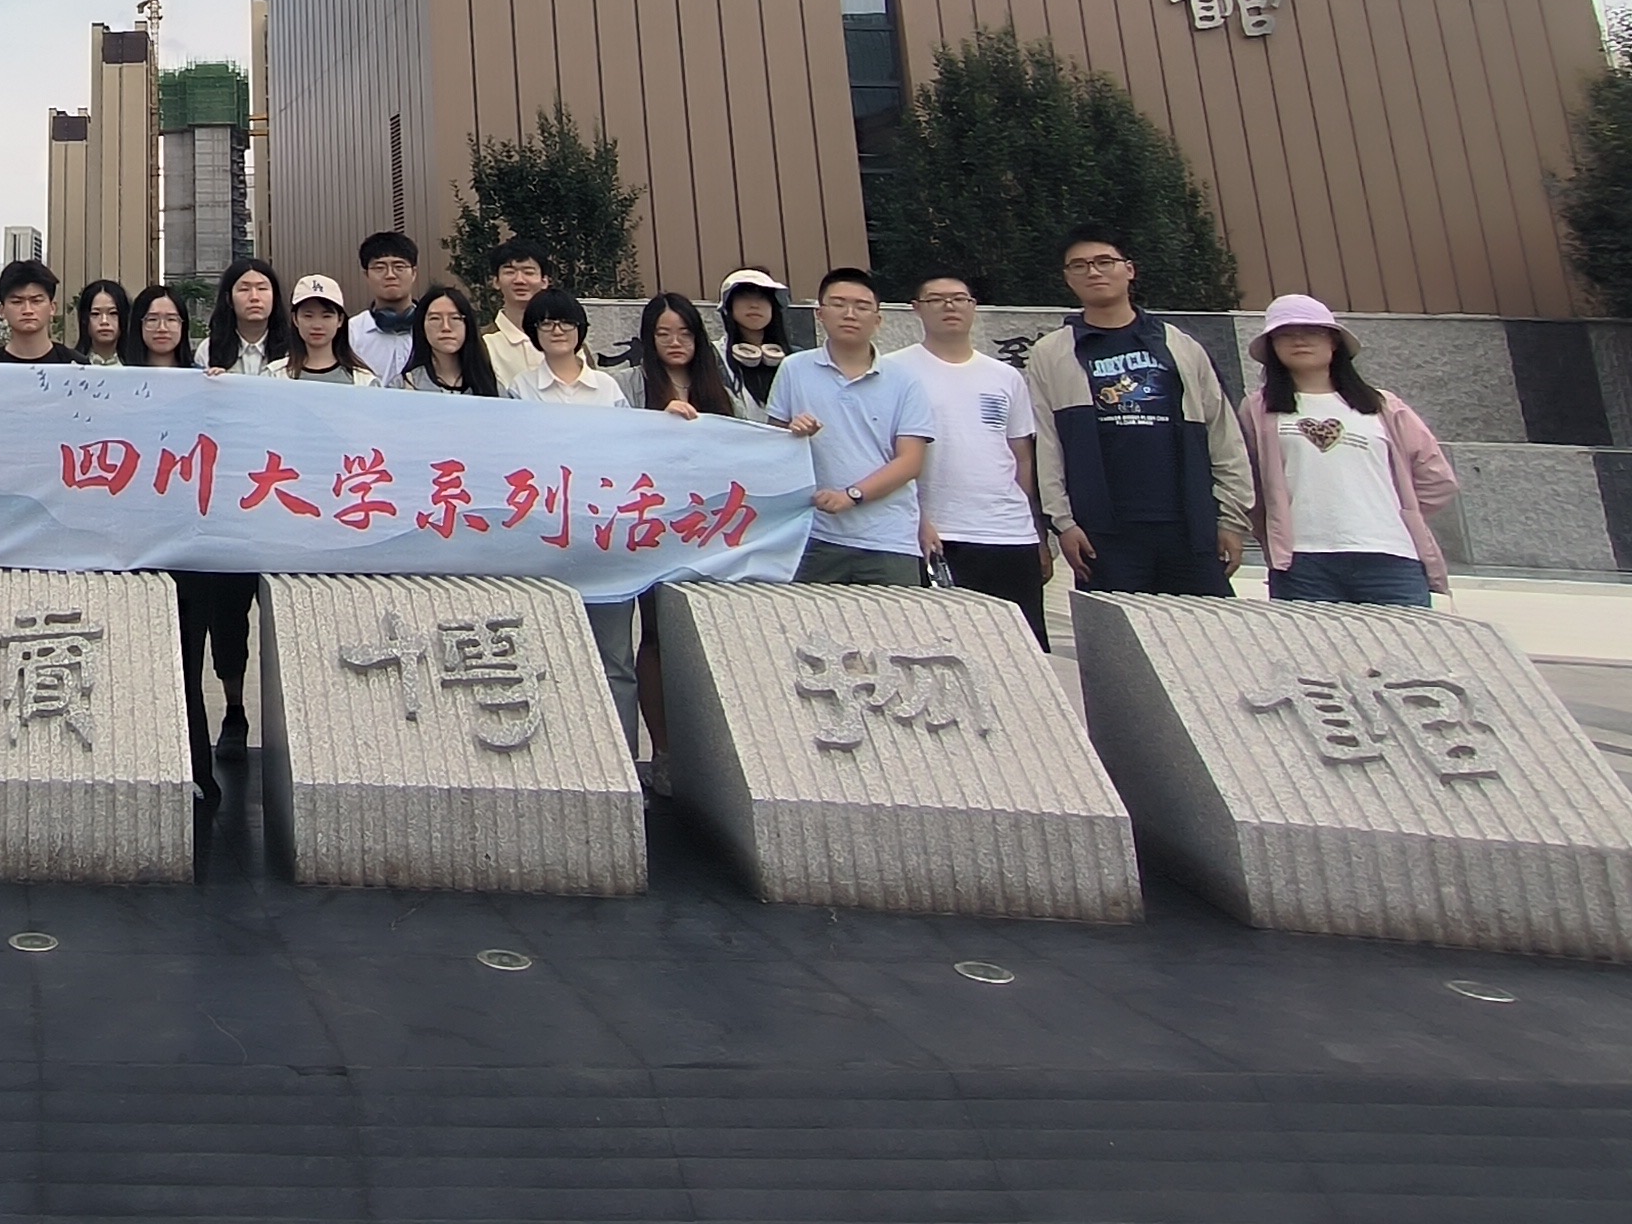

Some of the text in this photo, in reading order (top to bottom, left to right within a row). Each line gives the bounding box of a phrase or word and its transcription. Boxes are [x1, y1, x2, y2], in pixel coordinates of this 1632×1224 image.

[312, 280, 324, 292] LA
[59, 432, 759, 552] 四川大学系列活动
